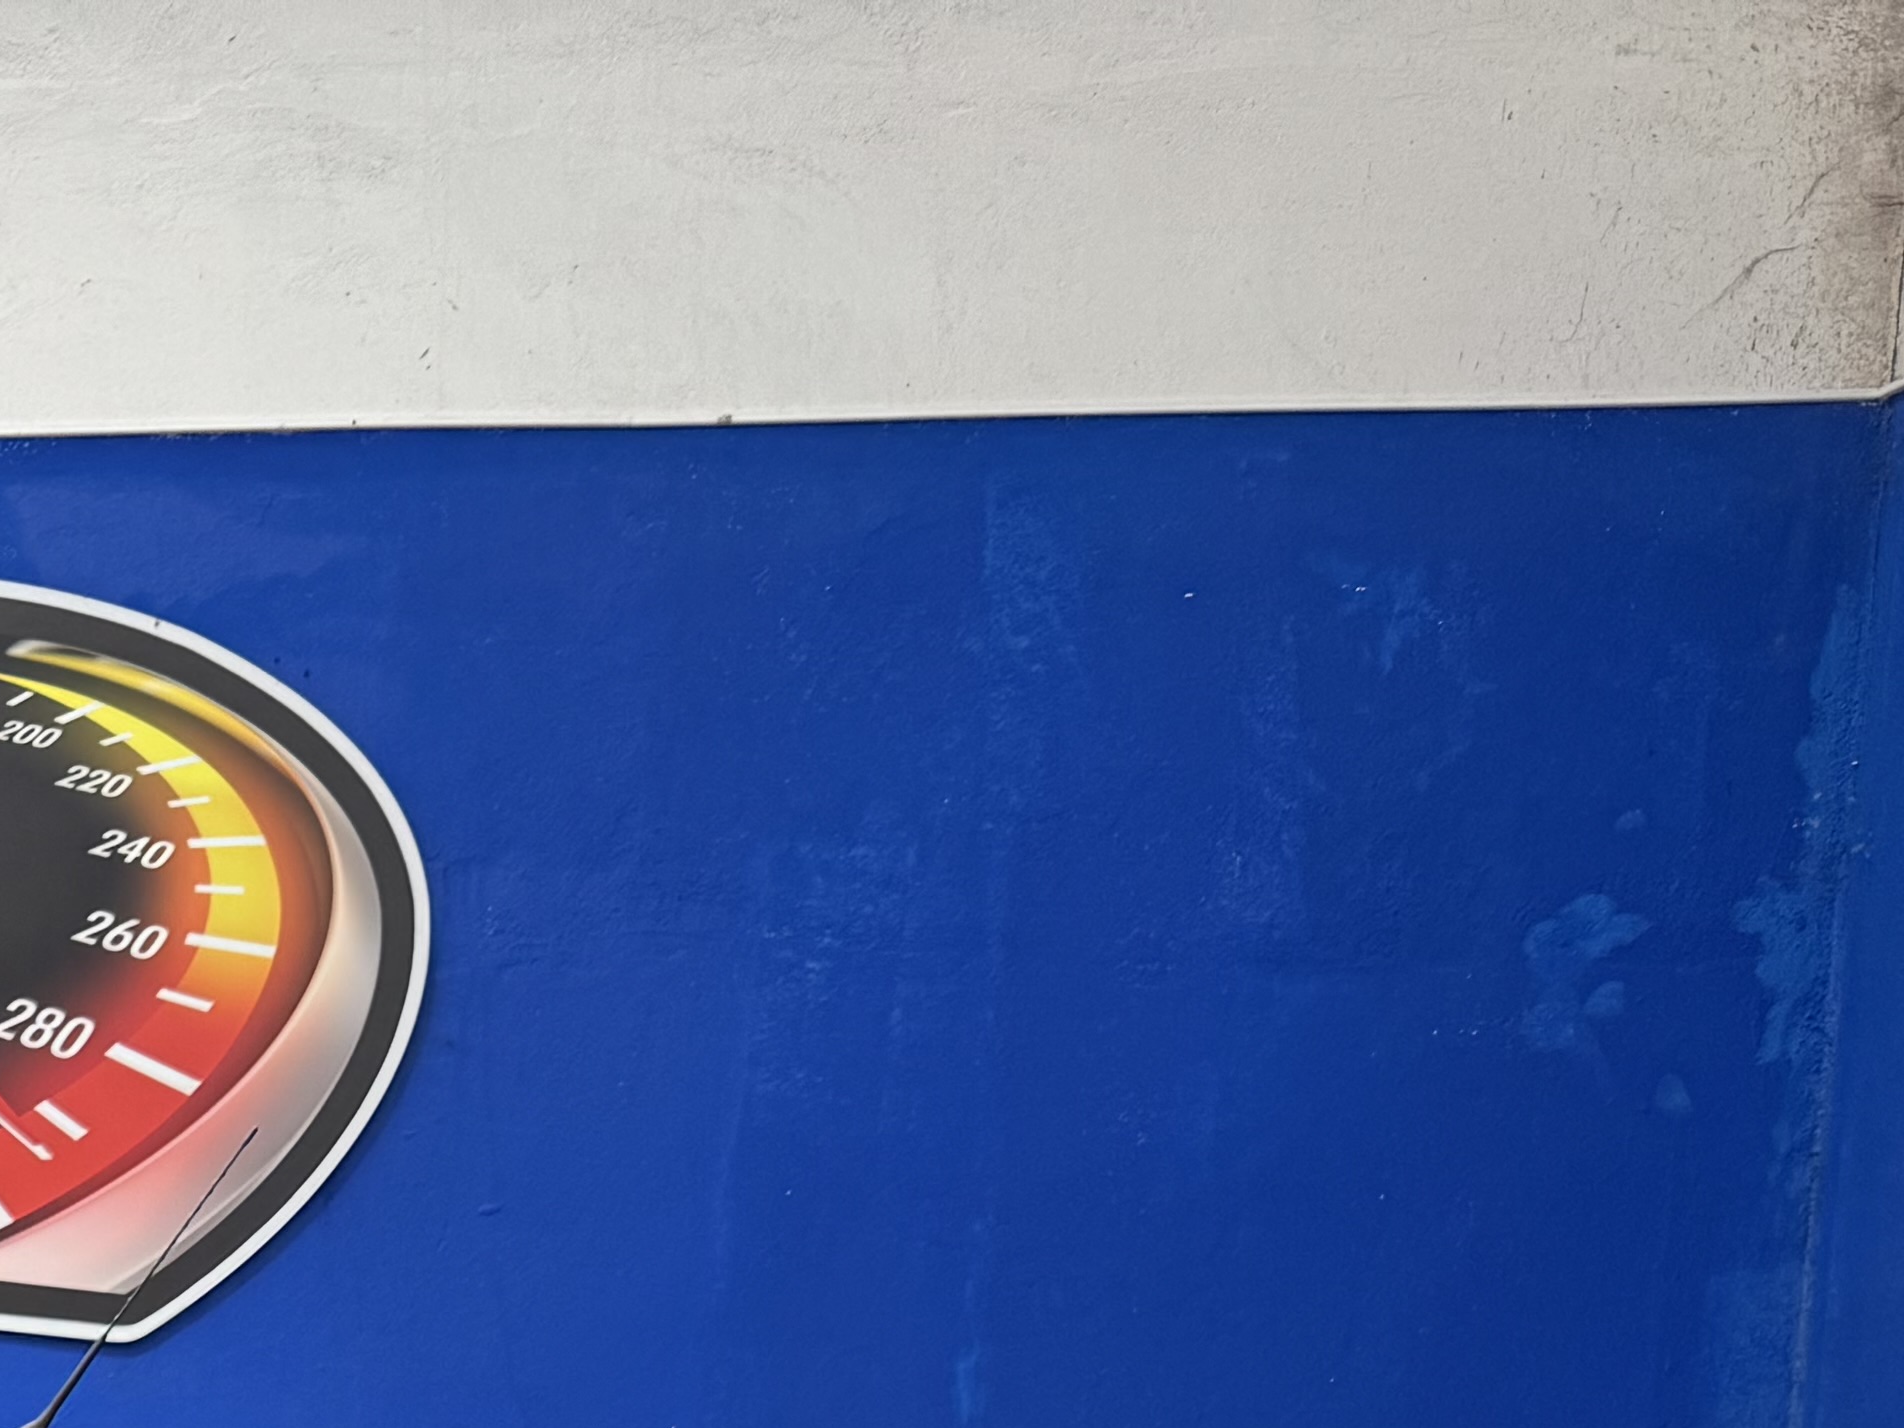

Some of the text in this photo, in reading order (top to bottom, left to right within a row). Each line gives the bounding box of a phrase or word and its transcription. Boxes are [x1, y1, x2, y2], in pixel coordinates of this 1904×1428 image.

[54, 765, 133, 798] 220
[87, 829, 176, 869] 240
[71, 911, 169, 960] 260
